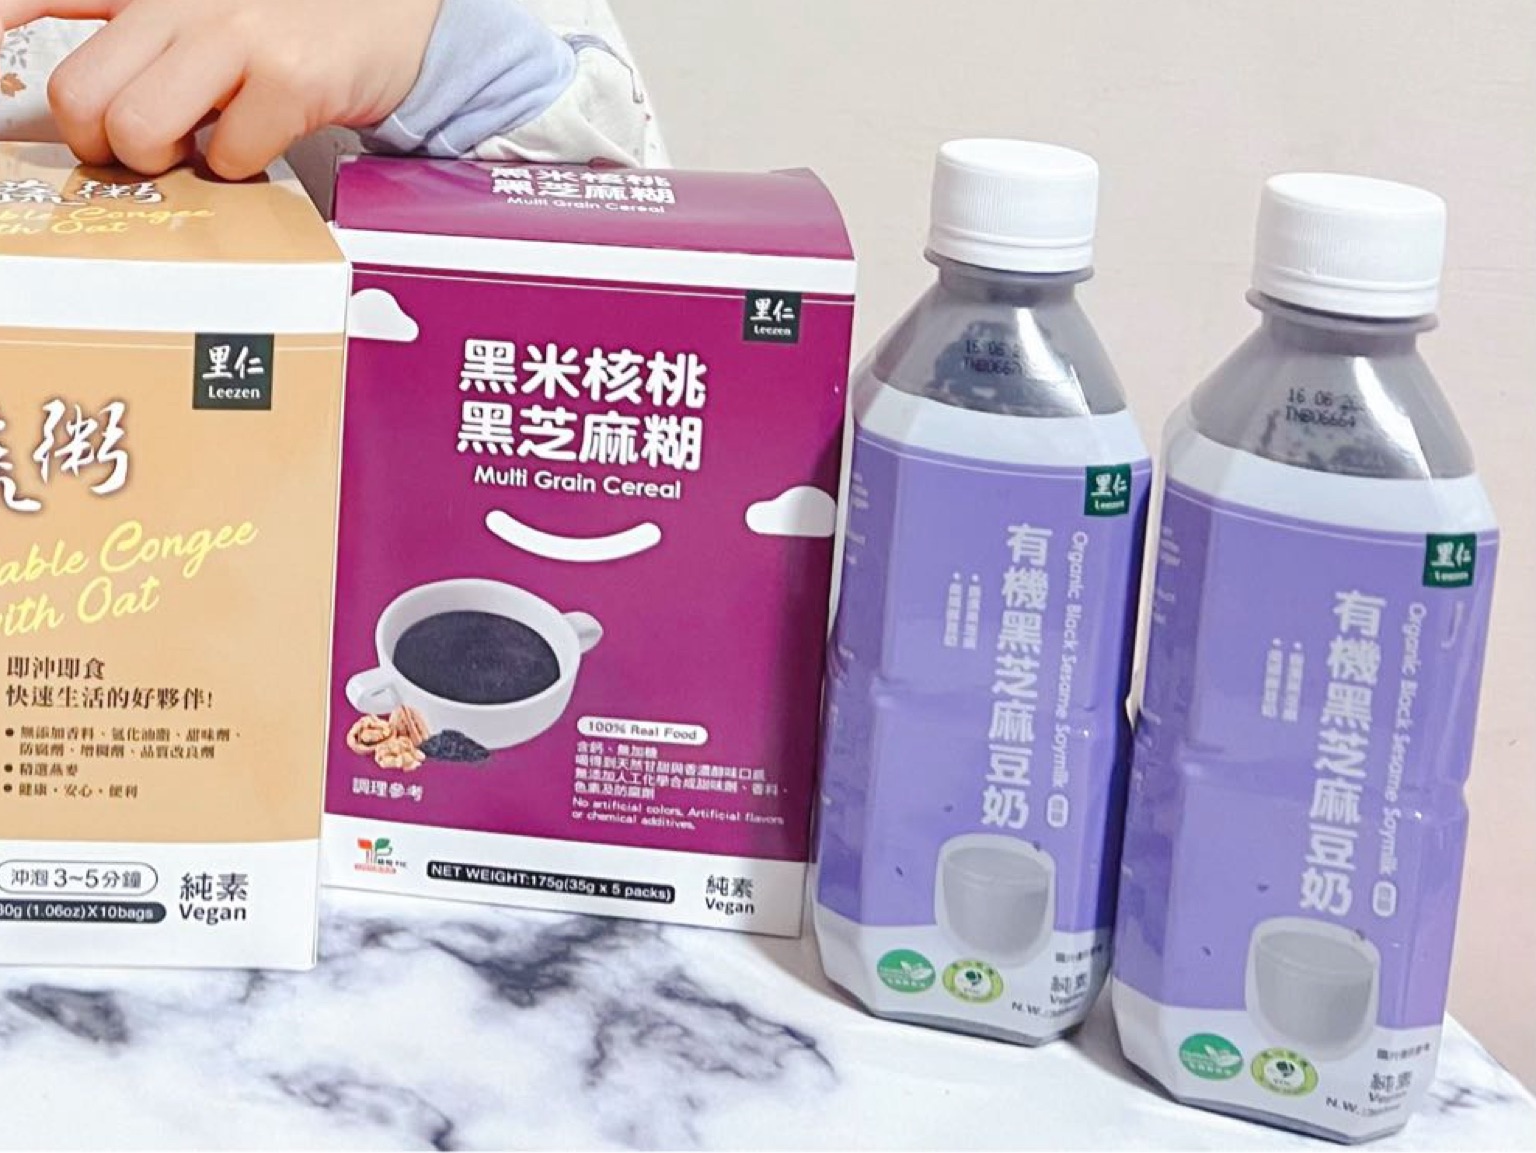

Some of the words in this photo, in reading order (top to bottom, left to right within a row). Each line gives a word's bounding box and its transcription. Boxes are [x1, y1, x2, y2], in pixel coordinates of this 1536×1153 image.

[68, 205, 215, 224] Congee
[506, 195, 549, 207] Multi
[553, 198, 601, 210] Grain
[605, 201, 665, 214] Cereal
[50, 219, 131, 236] Oat
[749, 297, 795, 323] 里仁
[202, 344, 264, 380] 里仁
[458, 337, 707, 409] 黑米核桃
[208, 384, 261, 400] Leezen
[456, 399, 703, 472] 黑芝麻糊
[474, 464, 529, 488] Multi
[533, 469, 596, 493] Grain
[602, 475, 681, 499] Cereal
[1089, 472, 1128, 497] 里仁
[98, 519, 259, 580] Congee
[1066, 530, 1089, 600] Organic
[1430, 541, 1472, 567] 里仁
[76, 574, 162, 625] Oat
[1062, 603, 1083, 651] Black
[1401, 601, 1428, 677] Organic
[980, 522, 1054, 831] 有機黑芝麻豆奶
[1394, 678, 1419, 730] Black
[587, 720, 627, 736] 100%
[630, 723, 659, 738] Real
[663, 725, 698, 741] Food
[1299, 589, 1388, 917] 有機黑芝麻豆奶
[1383, 732, 1411, 803] Sesame
[572, 797, 589, 809] No
[687, 806, 741, 822] Artificial
[179, 872, 250, 902] 純素
[430, 863, 463, 879] NET
[465, 866, 596, 896] WEIGHT:175g(35g
[611, 882, 621, 896] 5
[623, 885, 672, 903] packs)
[704, 874, 754, 900] 純素
[179, 903, 248, 925] Vegan
[704, 895, 756, 917] Vegan
